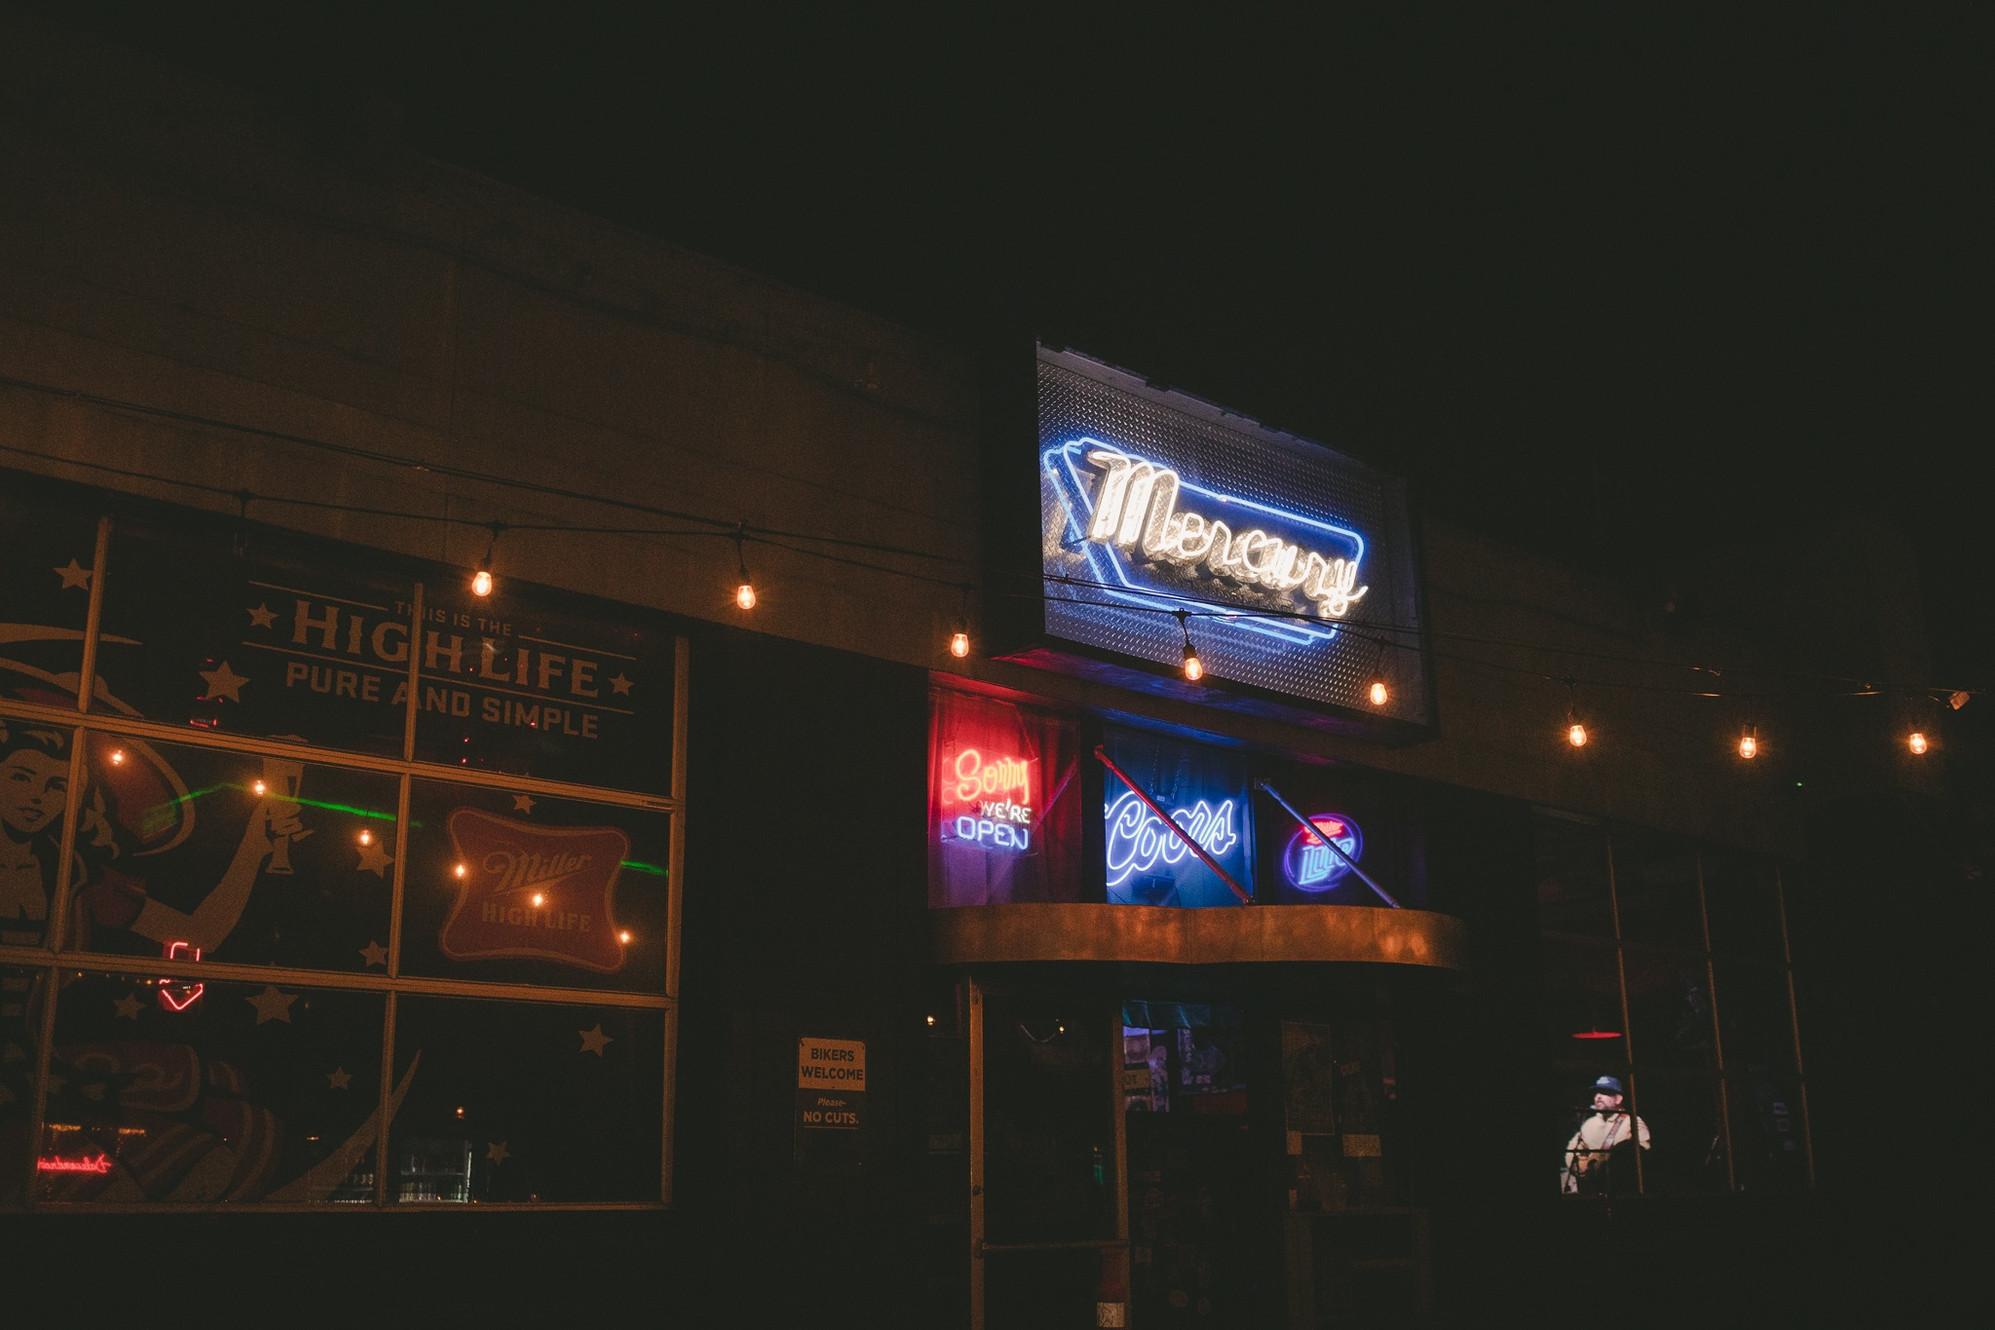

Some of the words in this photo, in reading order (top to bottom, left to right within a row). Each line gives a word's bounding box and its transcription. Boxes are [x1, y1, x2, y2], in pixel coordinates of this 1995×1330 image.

[1088, 450, 1368, 616] Mercury
[453, 613, 471, 629] IS
[477, 617, 513, 637] THE
[290, 599, 465, 674] HIGH
[478, 636, 600, 698] LIFE
[286, 661, 380, 703] PURE
[391, 685, 472, 719] AND
[482, 697, 600, 741] SIMPLE
[955, 748, 1030, 806] Sorry
[979, 798, 1032, 825] WE'RE
[956, 815, 1029, 850] OPEN
[484, 850, 592, 893] Miller
[482, 901, 537, 927] HIGH
[545, 911, 591, 932] LIFE
[811, 1047, 855, 1062] BIKERS
[801, 1065, 864, 1081] WELCOME
[803, 1111, 822, 1123] NO
[825, 1111, 860, 1125] CUTS.
